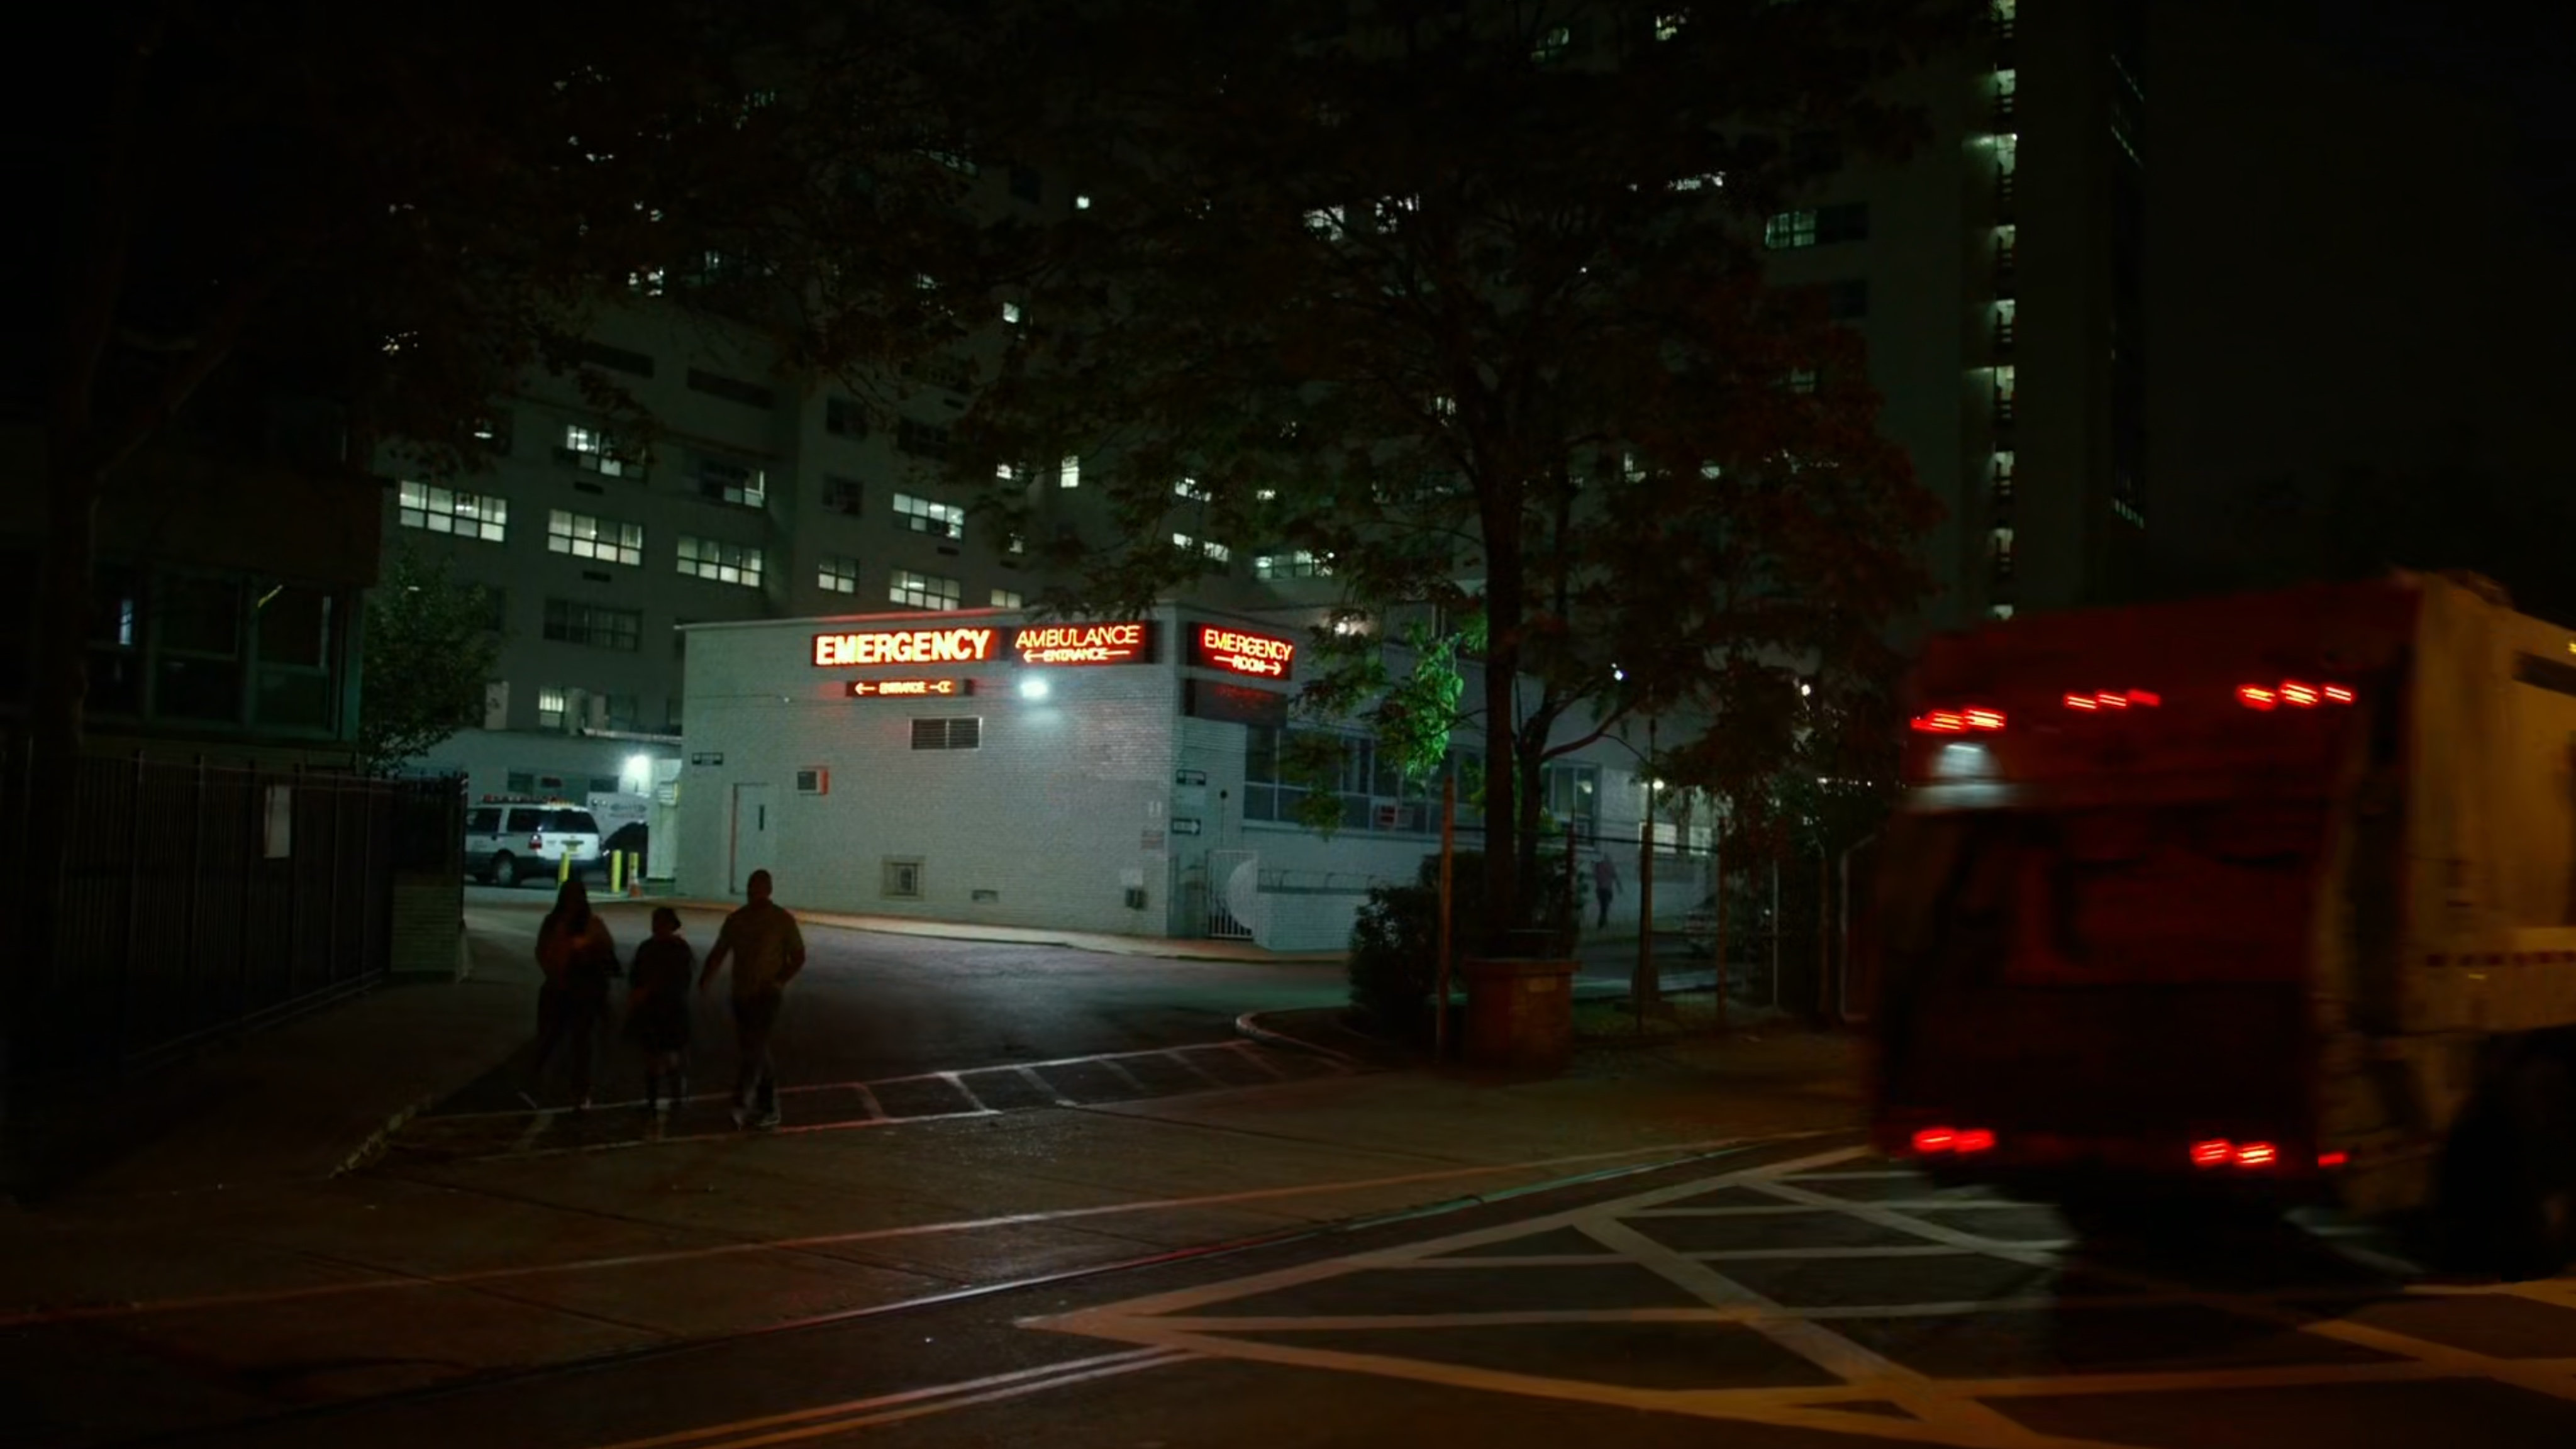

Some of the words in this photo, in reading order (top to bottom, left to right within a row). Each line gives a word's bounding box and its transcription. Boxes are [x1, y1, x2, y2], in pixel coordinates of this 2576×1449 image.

[816, 629, 991, 665] EMERGENCY
[1015, 625, 1141, 648] AMBULANCE
[1204, 629, 1292, 661] EMERGENCY
[1232, 655, 1266, 673] ROOM
